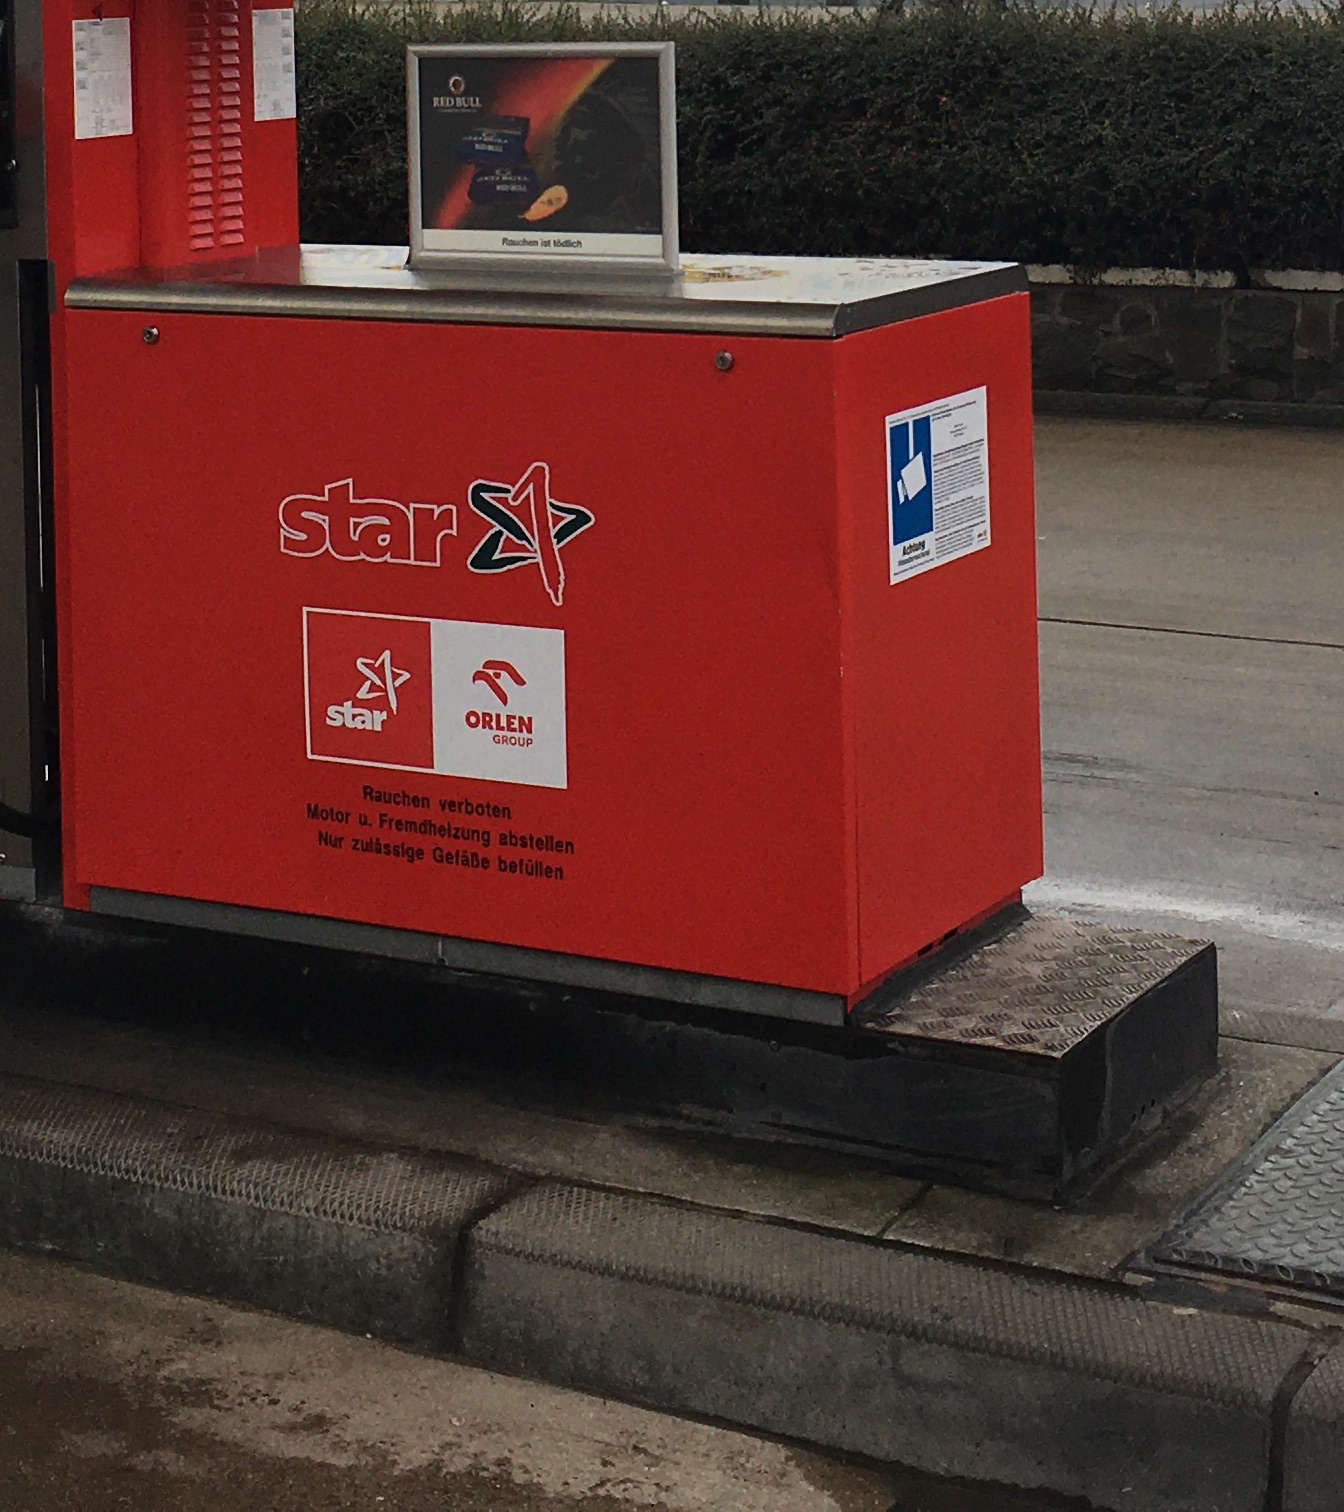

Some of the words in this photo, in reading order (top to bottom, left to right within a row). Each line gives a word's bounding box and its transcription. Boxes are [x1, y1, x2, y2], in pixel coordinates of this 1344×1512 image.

[433, 96, 455, 108] RED
[456, 96, 482, 108] BULL
[501, 237, 538, 247] Rauchen
[540, 238, 551, 248] ist
[553, 238, 583, 248] tödlich
[278, 477, 457, 567] star
[325, 700, 388, 731] star
[464, 709, 533, 735] ORLEN
[492, 734, 533, 748] GROUP
[362, 785, 431, 810] Rauchen
[438, 797, 512, 820] verboten
[306, 803, 351, 824] Motor
[358, 815, 373, 828] u.
[378, 813, 491, 848] Fremdheizung
[498, 830, 575, 855] abstellen
[317, 830, 344, 849] Nur
[351, 837, 425, 864] zulässige
[432, 846, 490, 870] Gefäße
[497, 855, 565, 880] befüllen
